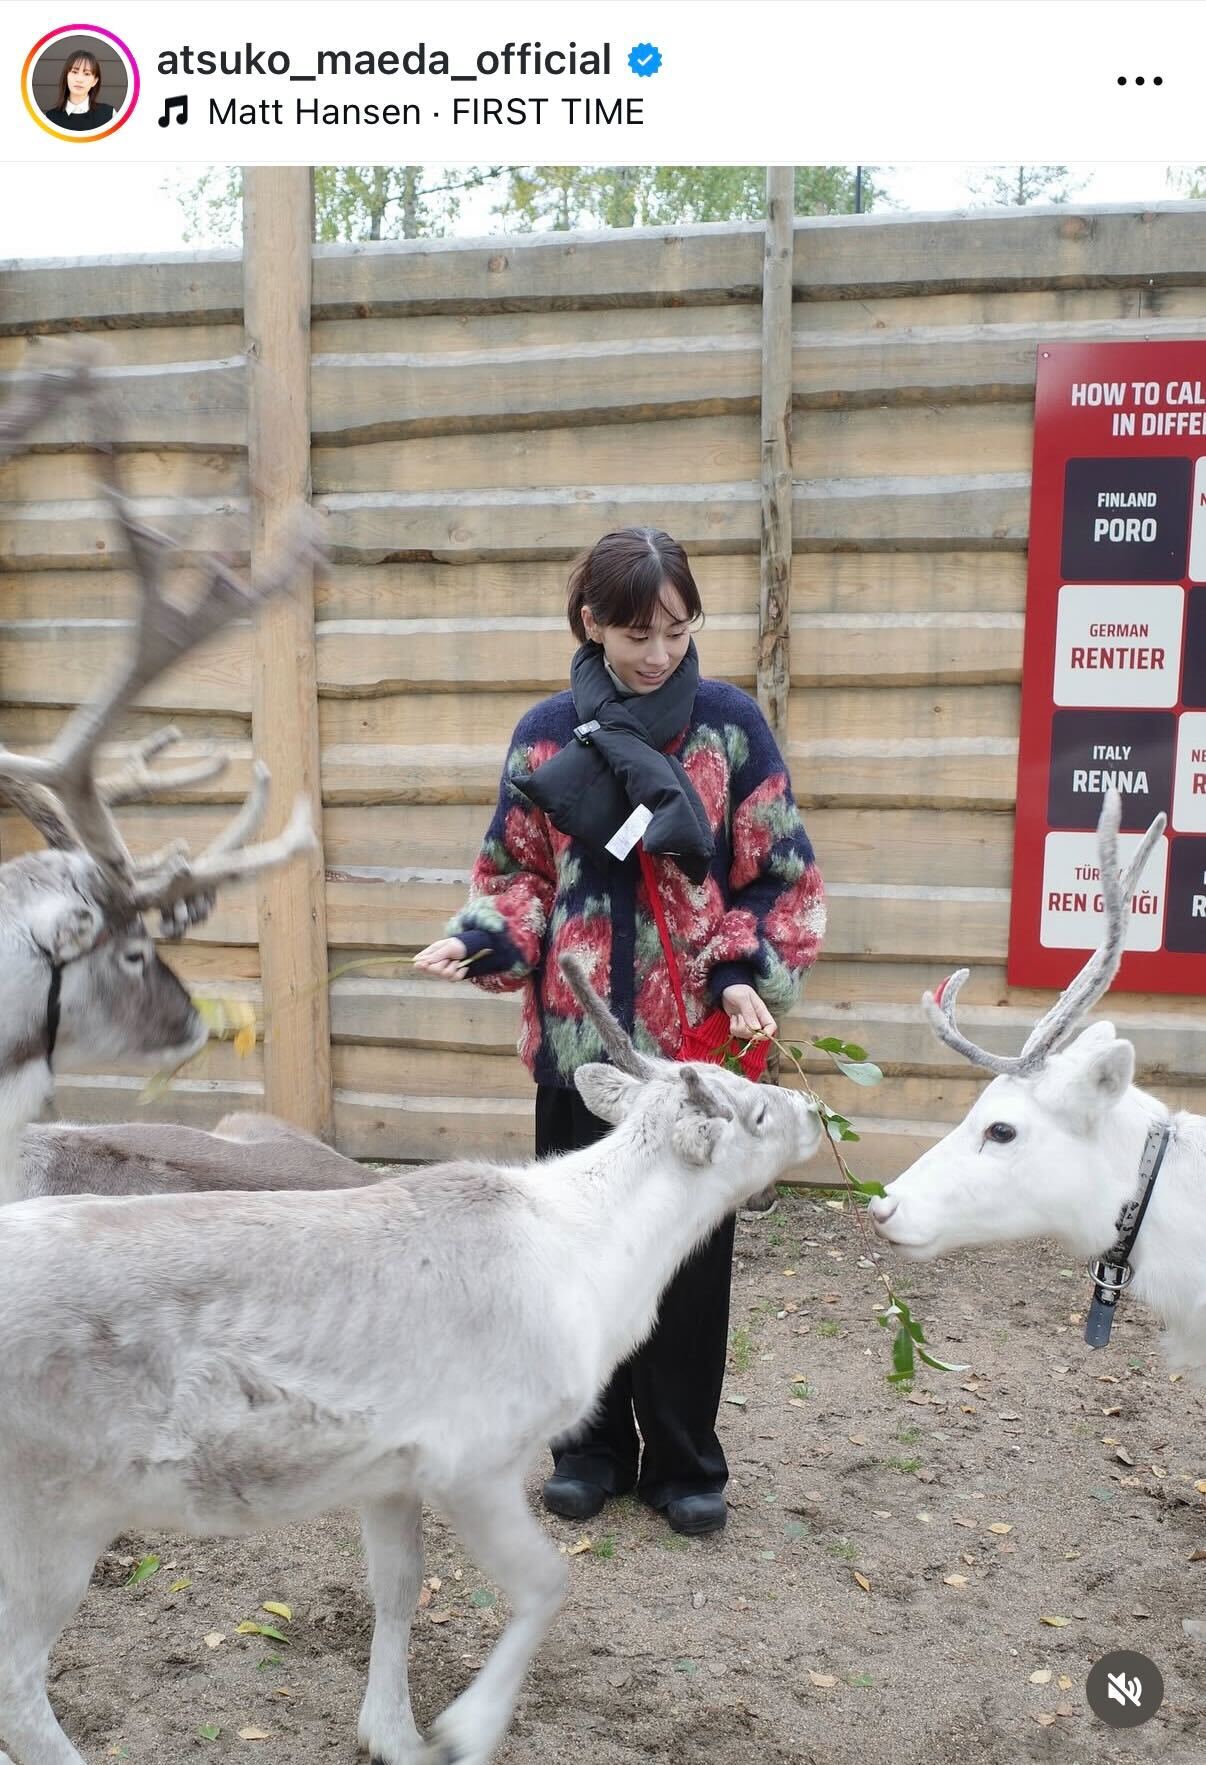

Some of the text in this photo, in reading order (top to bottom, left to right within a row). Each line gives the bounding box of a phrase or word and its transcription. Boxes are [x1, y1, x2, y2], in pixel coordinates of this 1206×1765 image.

[1071, 381, 1206, 406] HOW TO CAL
[1112, 412, 1206, 436] IN DIFFE
[1098, 492, 1157, 508] FINLAND
[1094, 518, 1158, 543] PORO
[1090, 623, 1149, 638] GERMAN
[1071, 647, 1165, 670] RENTIER
[1092, 745, 1132, 760] ITALY
[1073, 769, 1149, 794] RENNA
[1048, 890, 1158, 914] REN GIĞI
